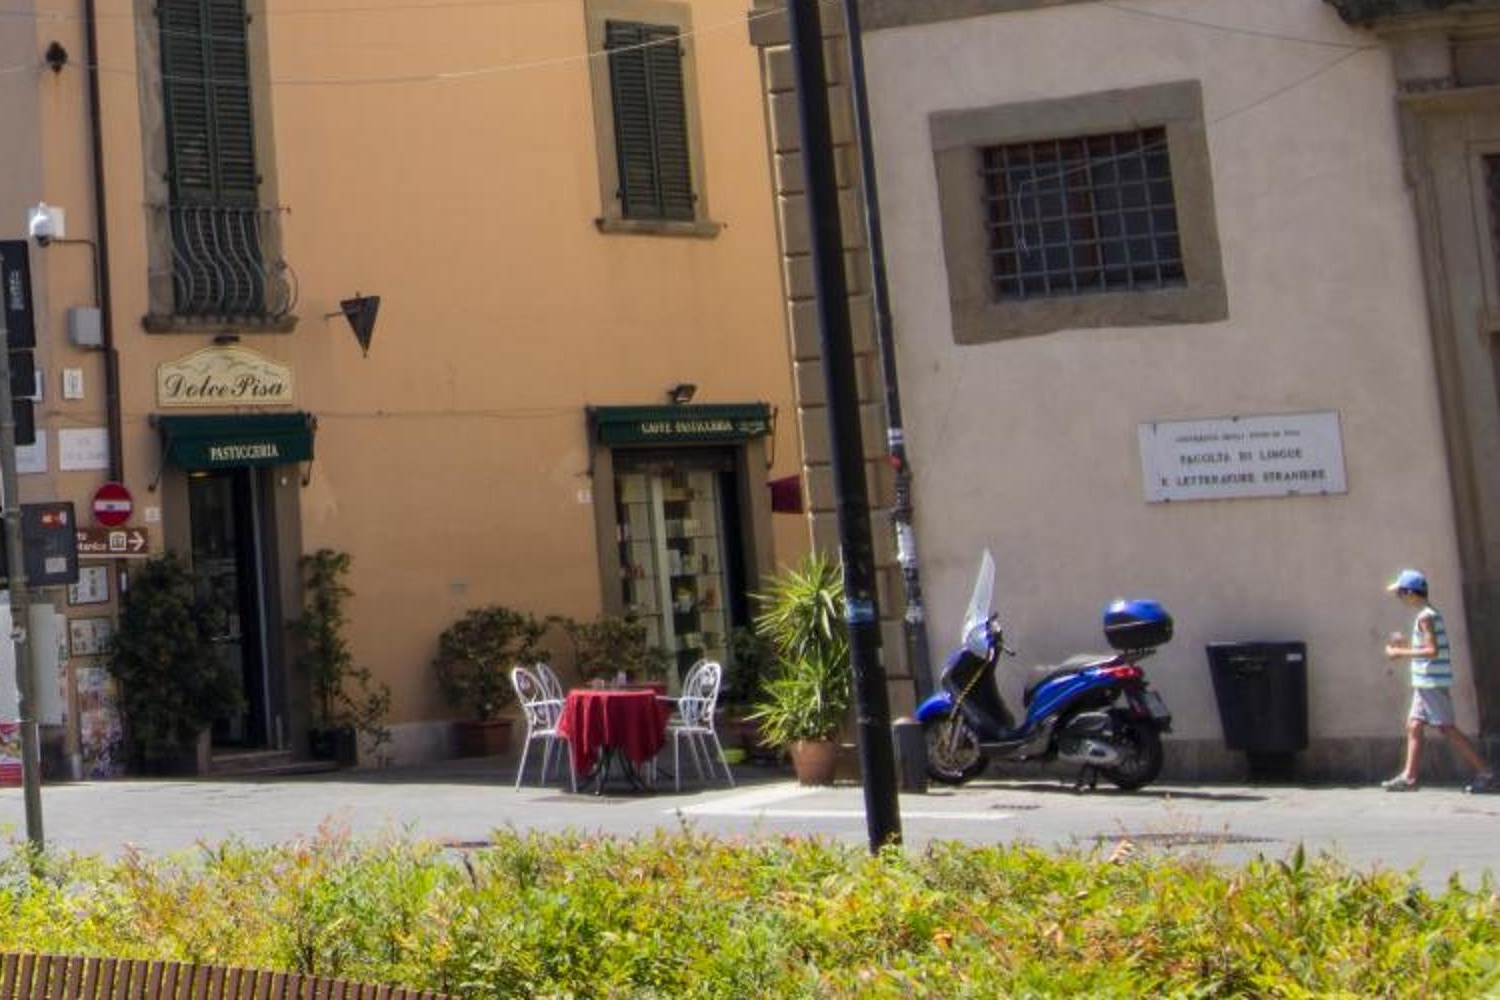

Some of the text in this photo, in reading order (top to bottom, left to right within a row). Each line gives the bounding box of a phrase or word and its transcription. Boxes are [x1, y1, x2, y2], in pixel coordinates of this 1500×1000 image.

[164, 373, 284, 398] Dolce Pisa
[210, 443, 279, 461] PASTICCERIA
